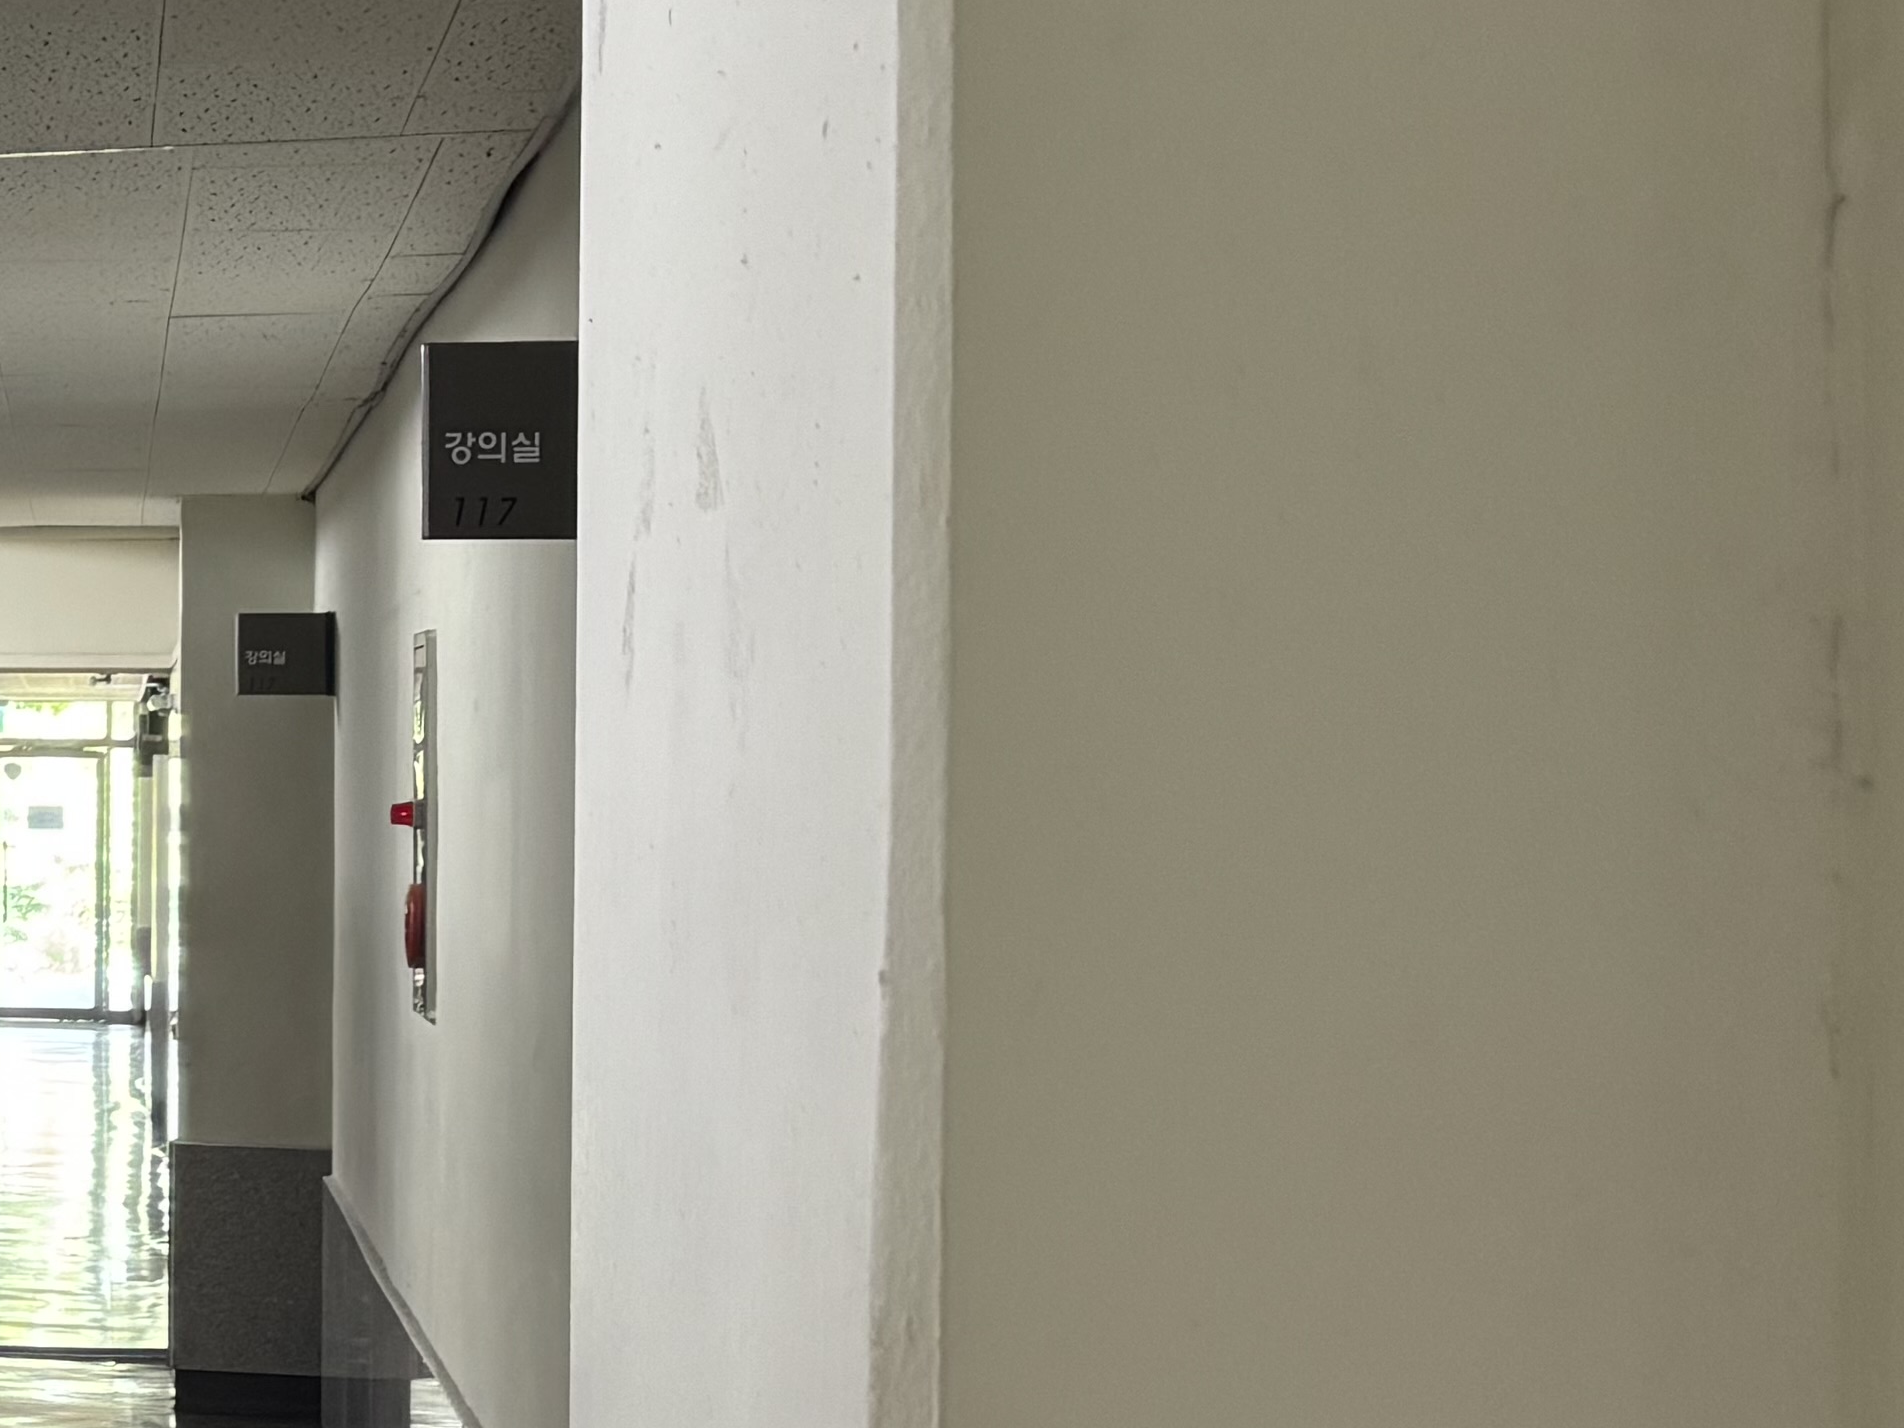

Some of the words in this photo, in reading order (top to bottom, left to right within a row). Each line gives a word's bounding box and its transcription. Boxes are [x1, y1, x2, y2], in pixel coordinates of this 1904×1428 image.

[445, 431, 542, 465] 강의실
[454, 496, 517, 526] 117
[244, 650, 287, 666] 강의실
